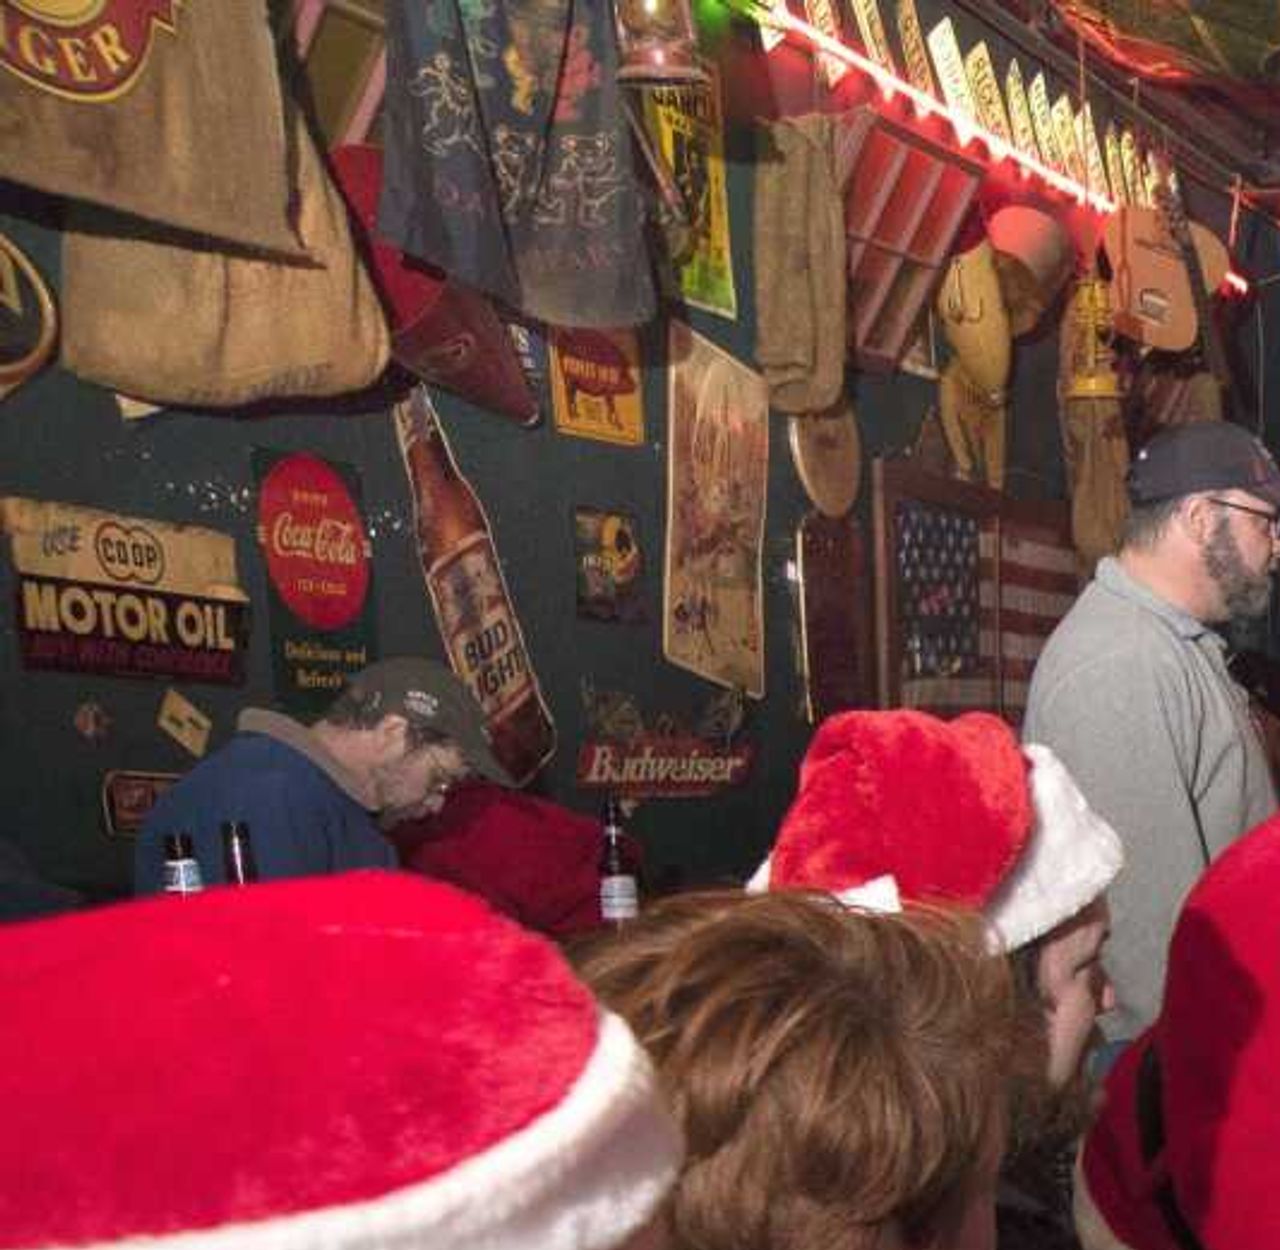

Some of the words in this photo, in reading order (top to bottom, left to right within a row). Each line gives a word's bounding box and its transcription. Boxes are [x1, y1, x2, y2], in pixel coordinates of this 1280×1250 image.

[22, 580, 170, 645] MOTOR
[176, 601, 235, 651] OIL
[465, 621, 508, 673] BUD
[476, 648, 526, 697] IGHT
[587, 744, 745, 783] Budweiser
